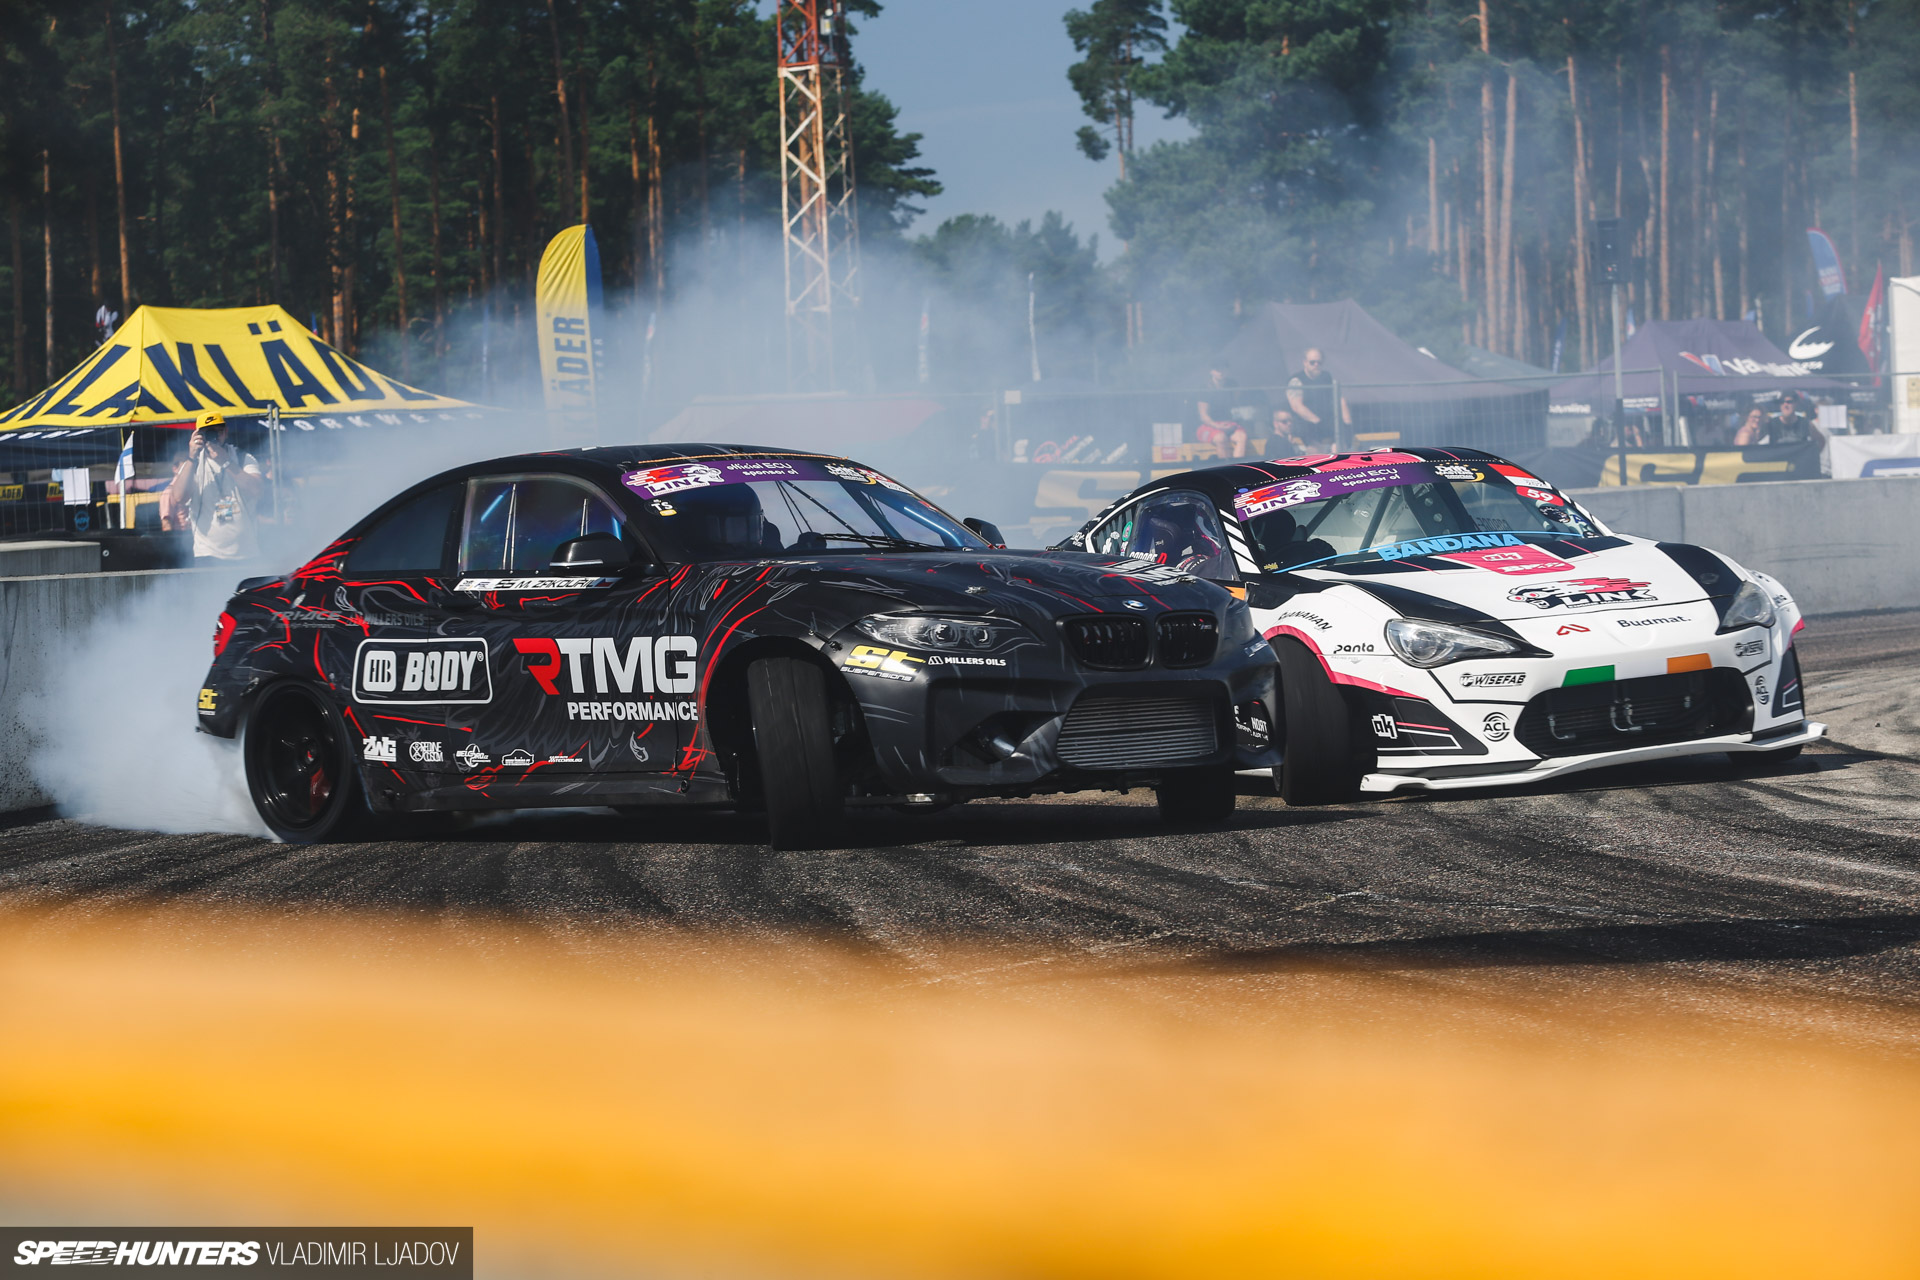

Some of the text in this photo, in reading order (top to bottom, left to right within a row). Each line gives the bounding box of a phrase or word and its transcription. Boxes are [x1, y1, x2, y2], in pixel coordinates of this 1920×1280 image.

[726, 462, 764, 471] official
[1328, 467, 1398, 483] official ECU
[1342, 473, 1402, 487] sponsor of
[647, 477, 708, 494] LINK
[1526, 488, 1554, 502] 59
[1244, 493, 1304, 515] LINK
[1376, 533, 1527, 562] BANDANA
[1558, 588, 1653, 606] LINK
[1333, 642, 1375, 654] panta
[512, 636, 698, 696] RTMG
[944, 656, 1007, 667] MILLERS OILS
[839, 665, 912, 682] SUSPENSIONS
[1475, 674, 1527, 685] WISEFAB
[567, 701, 699, 722] PERFORMANCE
[1483, 722, 1511, 733] ACL
